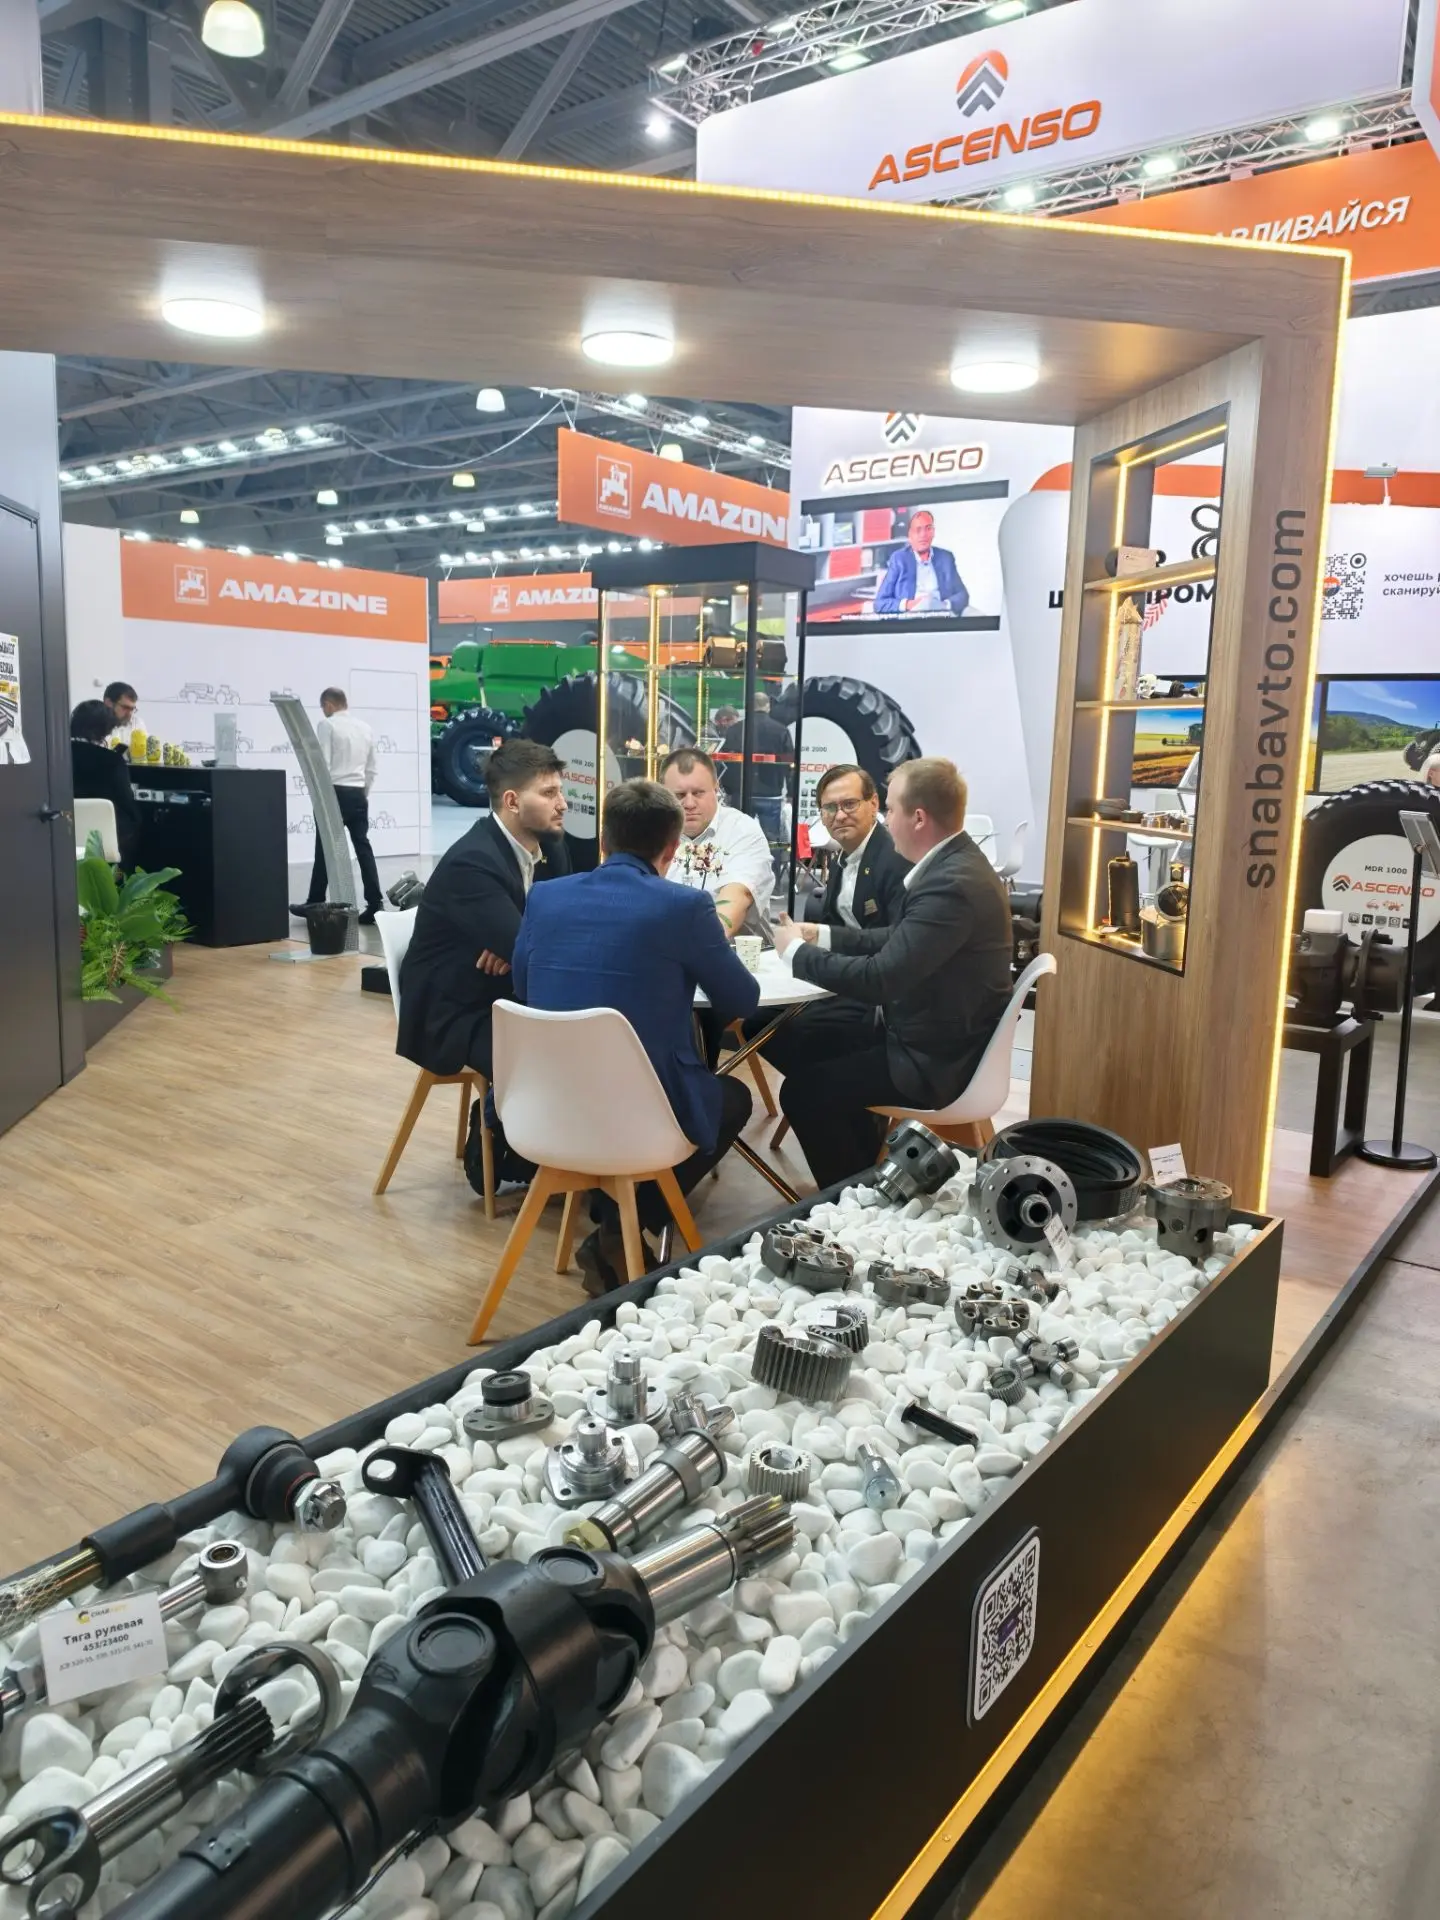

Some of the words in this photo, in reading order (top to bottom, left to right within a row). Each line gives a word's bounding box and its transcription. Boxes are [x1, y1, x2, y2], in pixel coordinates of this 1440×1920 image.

[868, 100, 1101, 190] ASCENSO
[1214, 196, 1410, 243] ЛИВАЙСЯ
[824, 447, 983, 485] ASCENSO
[641, 482, 787, 541] AMAZON
[1384, 573, 1433, 582] хочешь
[219, 578, 387, 615] AMAZONE
[1246, 510, 1306, 889] snabavto.com
[563, 771, 615, 790] ASCENO
[1364, 865, 1384, 873] MDR
[1351, 881, 1436, 897] ASCENO
[63, 1632, 91, 1645] Тяга
[95, 1618, 144, 1638] рулевая
[82, 1634, 129, 1652] 453/23400
